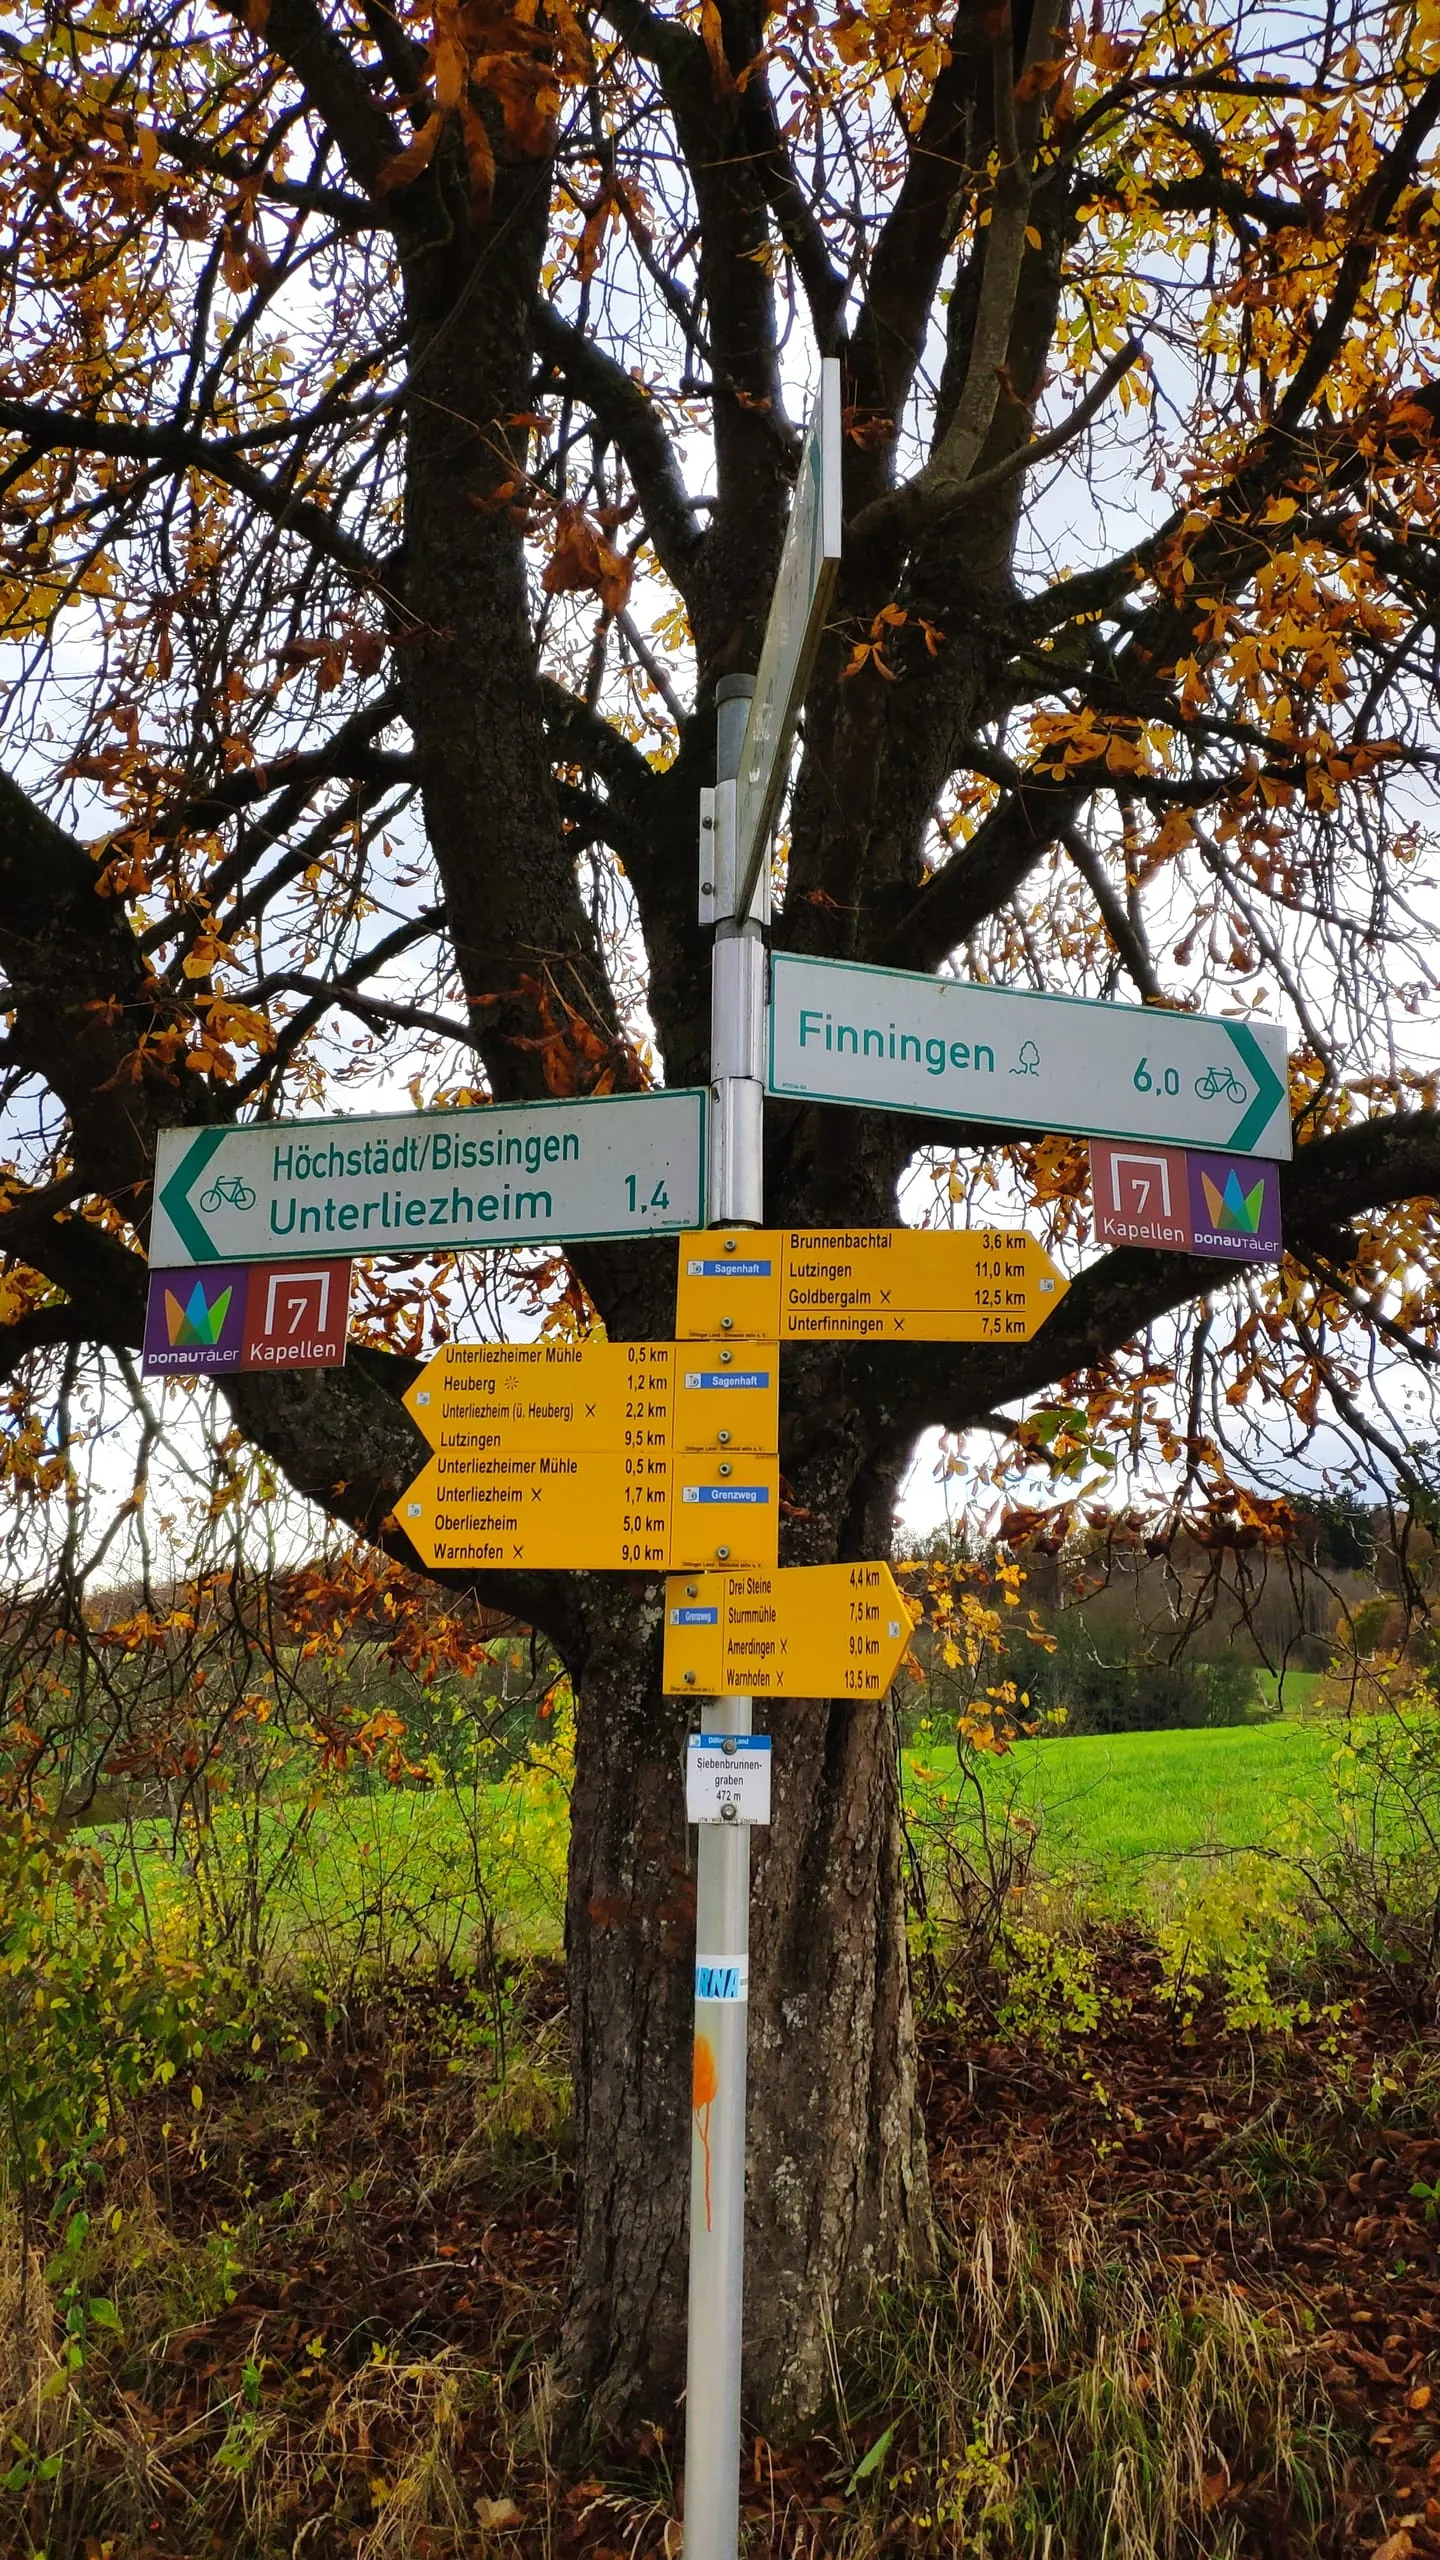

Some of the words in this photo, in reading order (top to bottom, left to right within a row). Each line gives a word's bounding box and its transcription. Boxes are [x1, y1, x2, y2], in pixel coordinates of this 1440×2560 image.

[799, 1009, 995, 1077] Finningen
[1132, 1057, 1180, 1097] 6,0
[272, 1128, 580, 1182] Höchstädt/Bissingen
[624, 1174, 670, 1215] 1,4
[270, 1184, 553, 1235] Unterliezheim
[1103, 1218, 1185, 1243] Kapellen
[790, 1233, 893, 1250] Brunnenbachtal
[982, 1234, 1002, 1250] 3,6
[1006, 1234, 1026, 1249] km
[714, 1263, 760, 1276] Sagenhaft
[789, 1262, 852, 1280] Lutzingen
[974, 1263, 1000, 1279] 11,0
[1005, 1263, 1025, 1278] km
[788, 1289, 871, 1307] Goldbergalm
[974, 1290, 1001, 1306] 12,5
[1005, 1290, 1026, 1305] km
[788, 1316, 883, 1334] Unterfinningen
[982, 1318, 1001, 1334] 7,5
[1005, 1317, 1026, 1333] km
[250, 1341, 337, 1364] Kapellen
[445, 1347, 542, 1363] Unterliezheimer
[545, 1347, 583, 1363] Mühle
[628, 1348, 645, 1364] 0,5
[649, 1347, 668, 1362] km
[443, 1376, 496, 1393] Heuberg
[627, 1375, 646, 1392] 1,2
[649, 1375, 667, 1390] km
[712, 1375, 758, 1388] Sagenhaft
[442, 1403, 510, 1419] Unterliezheim
[512, 1403, 526, 1421] (ü.
[528, 1403, 574, 1421] Heuberg)
[625, 1403, 645, 1419] 2,2
[648, 1403, 666, 1418] km
[440, 1431, 501, 1449] Lutzingen
[625, 1431, 645, 1447] 9,5
[647, 1431, 666, 1446] km
[437, 1458, 536, 1474] Unterliezheimer
[540, 1458, 578, 1474] Mühle
[625, 1458, 644, 1475] 0,5
[647, 1458, 666, 1474] km
[436, 1487, 523, 1503] Unterliezheim
[624, 1487, 644, 1504] 1,7
[646, 1488, 666, 1503] km
[711, 1489, 757, 1501] Grenzweg
[434, 1516, 517, 1532] Oberliezheim
[623, 1516, 642, 1533] 5,0
[645, 1516, 665, 1532] km
[433, 1544, 504, 1560] Warnhofen
[621, 1545, 641, 1562] 9,0
[644, 1545, 664, 1561] km
[729, 1578, 745, 1596] Drei
[747, 1577, 772, 1595] Steine
[849, 1568, 863, 1589] 4,4
[866, 1568, 880, 1587] km
[728, 1604, 776, 1624] Sturmmühle
[849, 1602, 863, 1623] 7,5
[866, 1602, 880, 1620] km
[727, 1638, 776, 1660] Amerdingen
[849, 1636, 863, 1657] 9,0
[866, 1635, 880, 1655] km
[726, 1668, 770, 1687] Warnhofen
[844, 1669, 863, 1690] 13,5
[866, 1669, 880, 1689] km
[696, 1757, 763, 1770] Siebenbrunnen-
[714, 1775, 744, 1787] graben
[716, 1790, 731, 1801] 472
[733, 1792, 741, 1801] m
